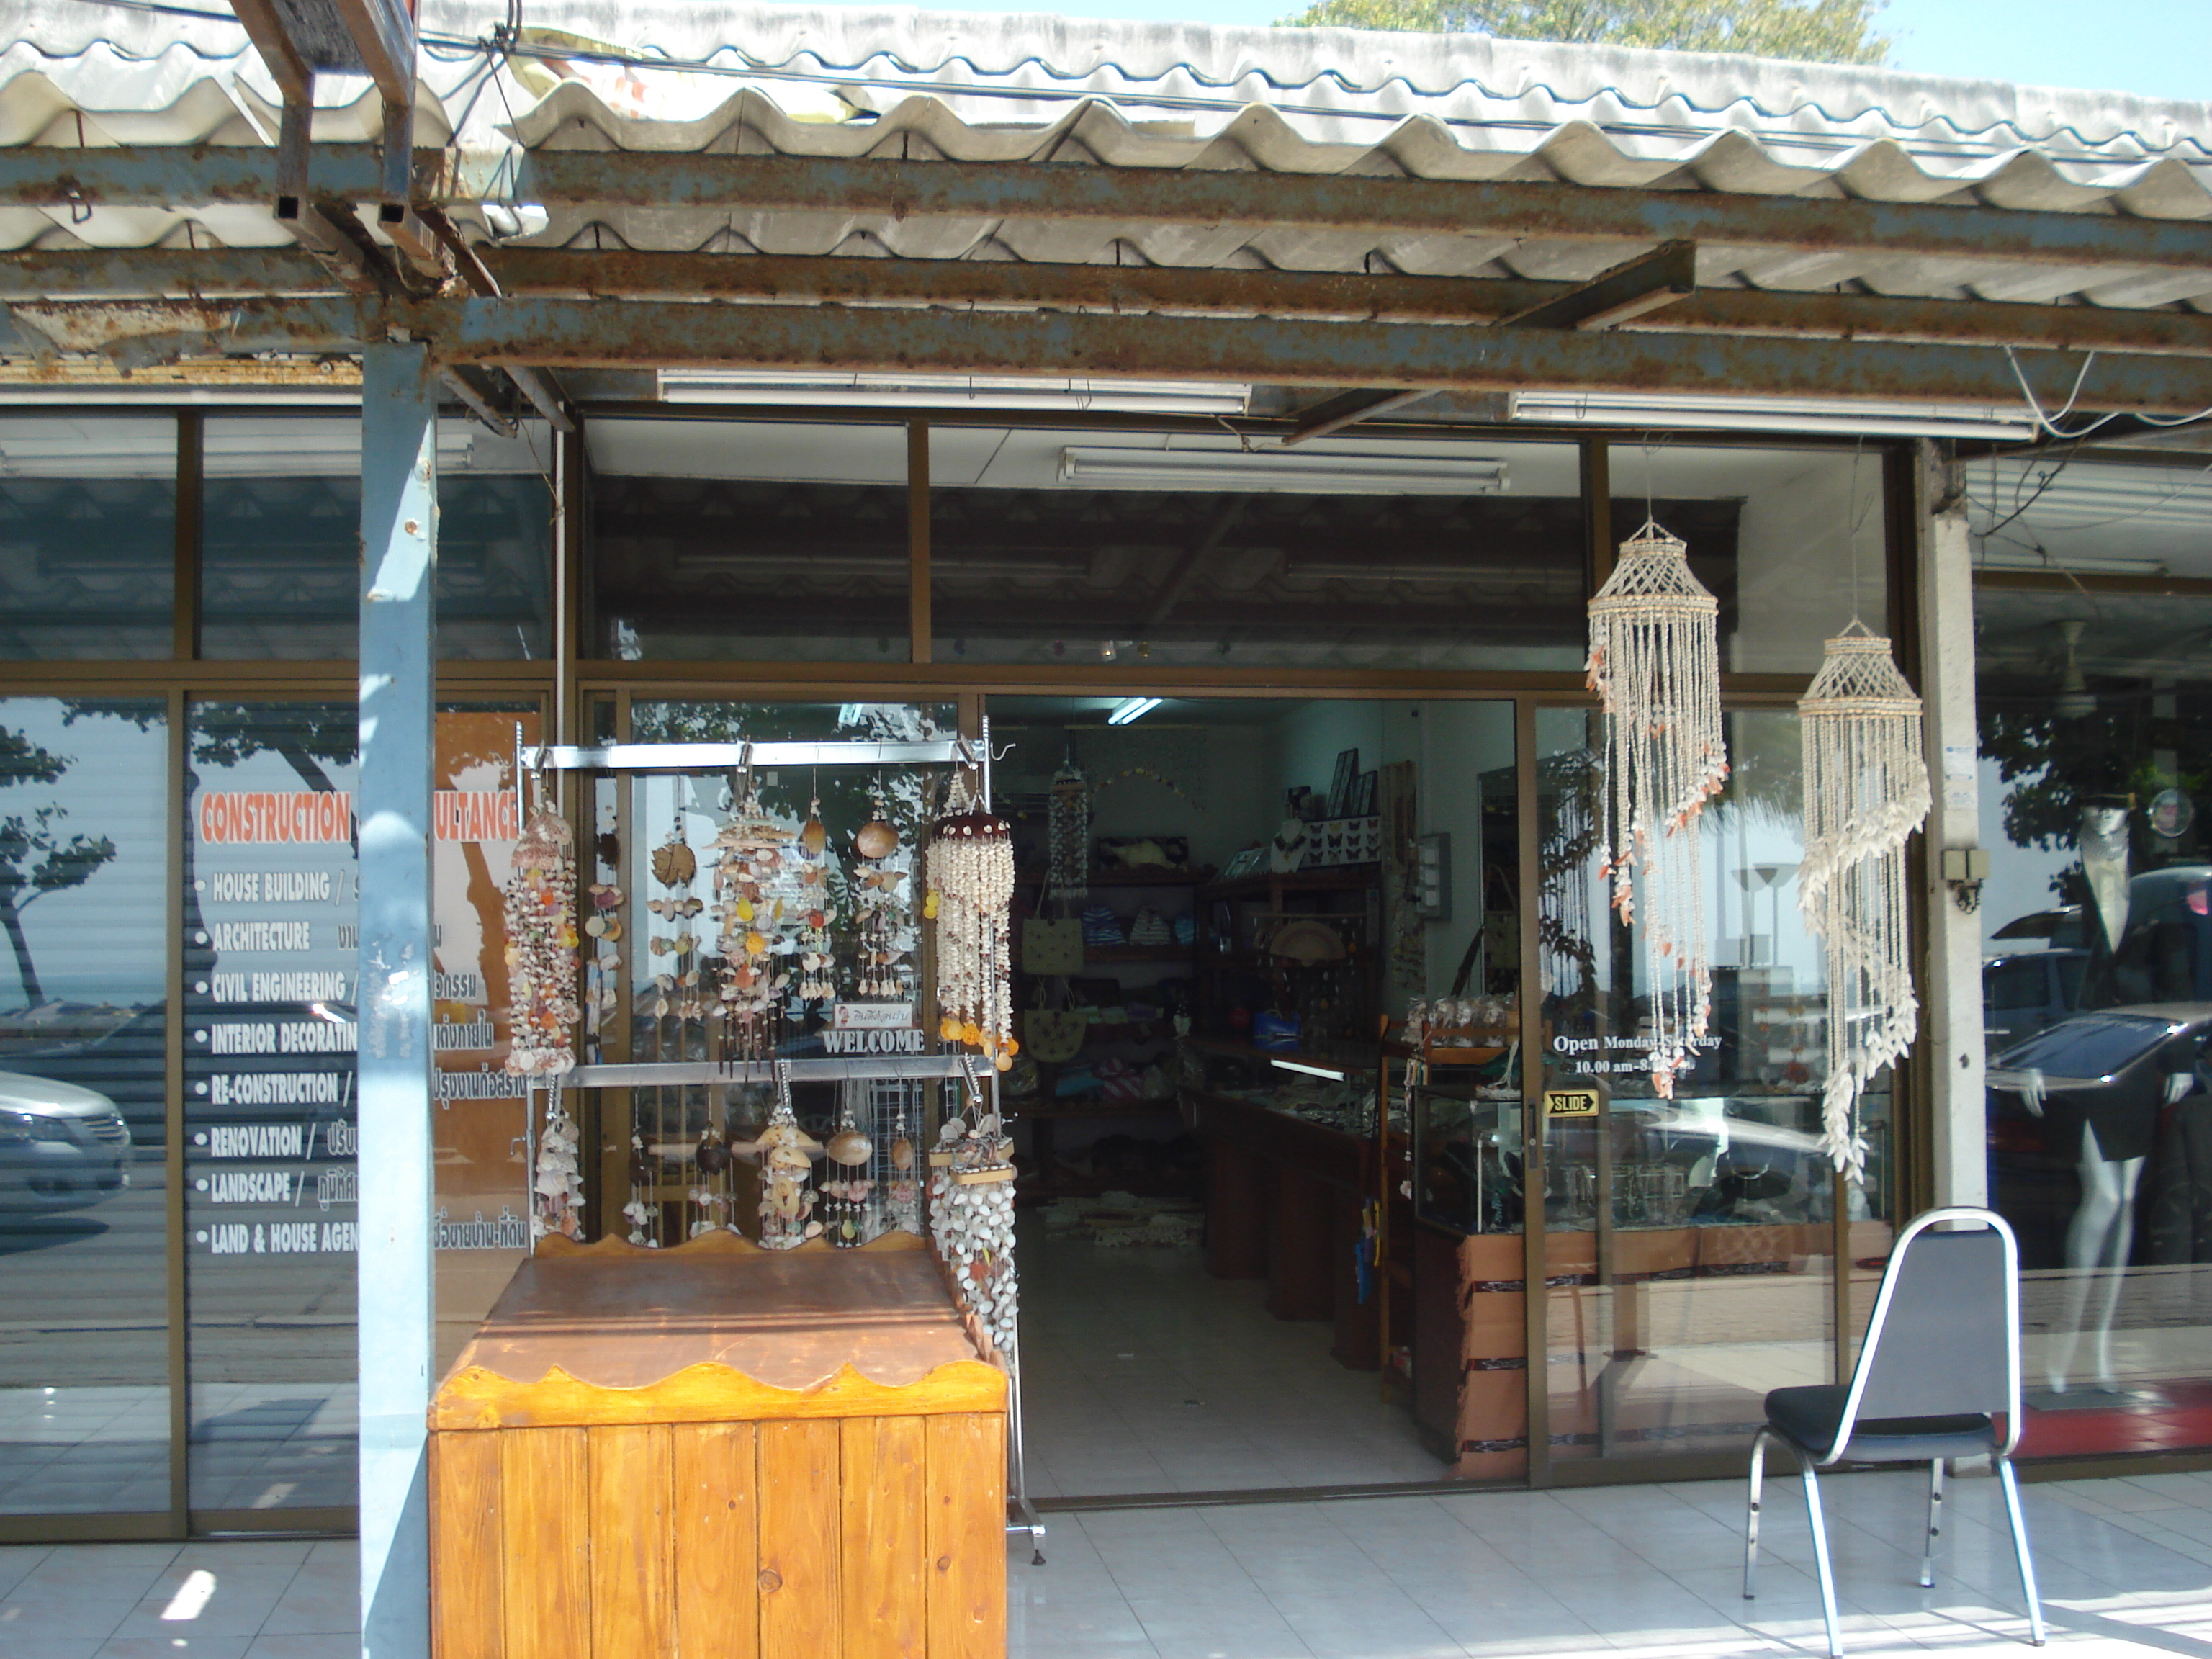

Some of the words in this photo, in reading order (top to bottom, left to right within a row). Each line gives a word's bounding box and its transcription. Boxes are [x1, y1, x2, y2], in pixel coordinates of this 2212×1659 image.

[200, 791, 351, 843] CONSTRUCTION
[212, 872, 259, 902] HOUSE
[264, 871, 331, 902] BUILDING
[212, 921, 310, 951] ARCHITECTURE
[212, 972, 247, 1002] CIVIL
[252, 971, 346, 1002] ENGINEERING
[211, 1022, 277, 1054] INTERIOR
[280, 1021, 359, 1053] DECORATIN
[822, 1028, 925, 1053] WELCOME
[1552, 1035, 1599, 1055] Open
[1575, 1060, 1611, 1074] 10.00
[211, 1073, 338, 1105] RE-CONSTRUCTION
[1554, 1095, 1588, 1112] SLIDE
[210, 1125, 302, 1157] RENOVATION
[211, 1172, 291, 1203] LANDSCAPE
[211, 1223, 250, 1254] LAND
[253, 1223, 266, 1254] &
[270, 1223, 317, 1253] HOUSE
[320, 1222, 359, 1252] AGEN
